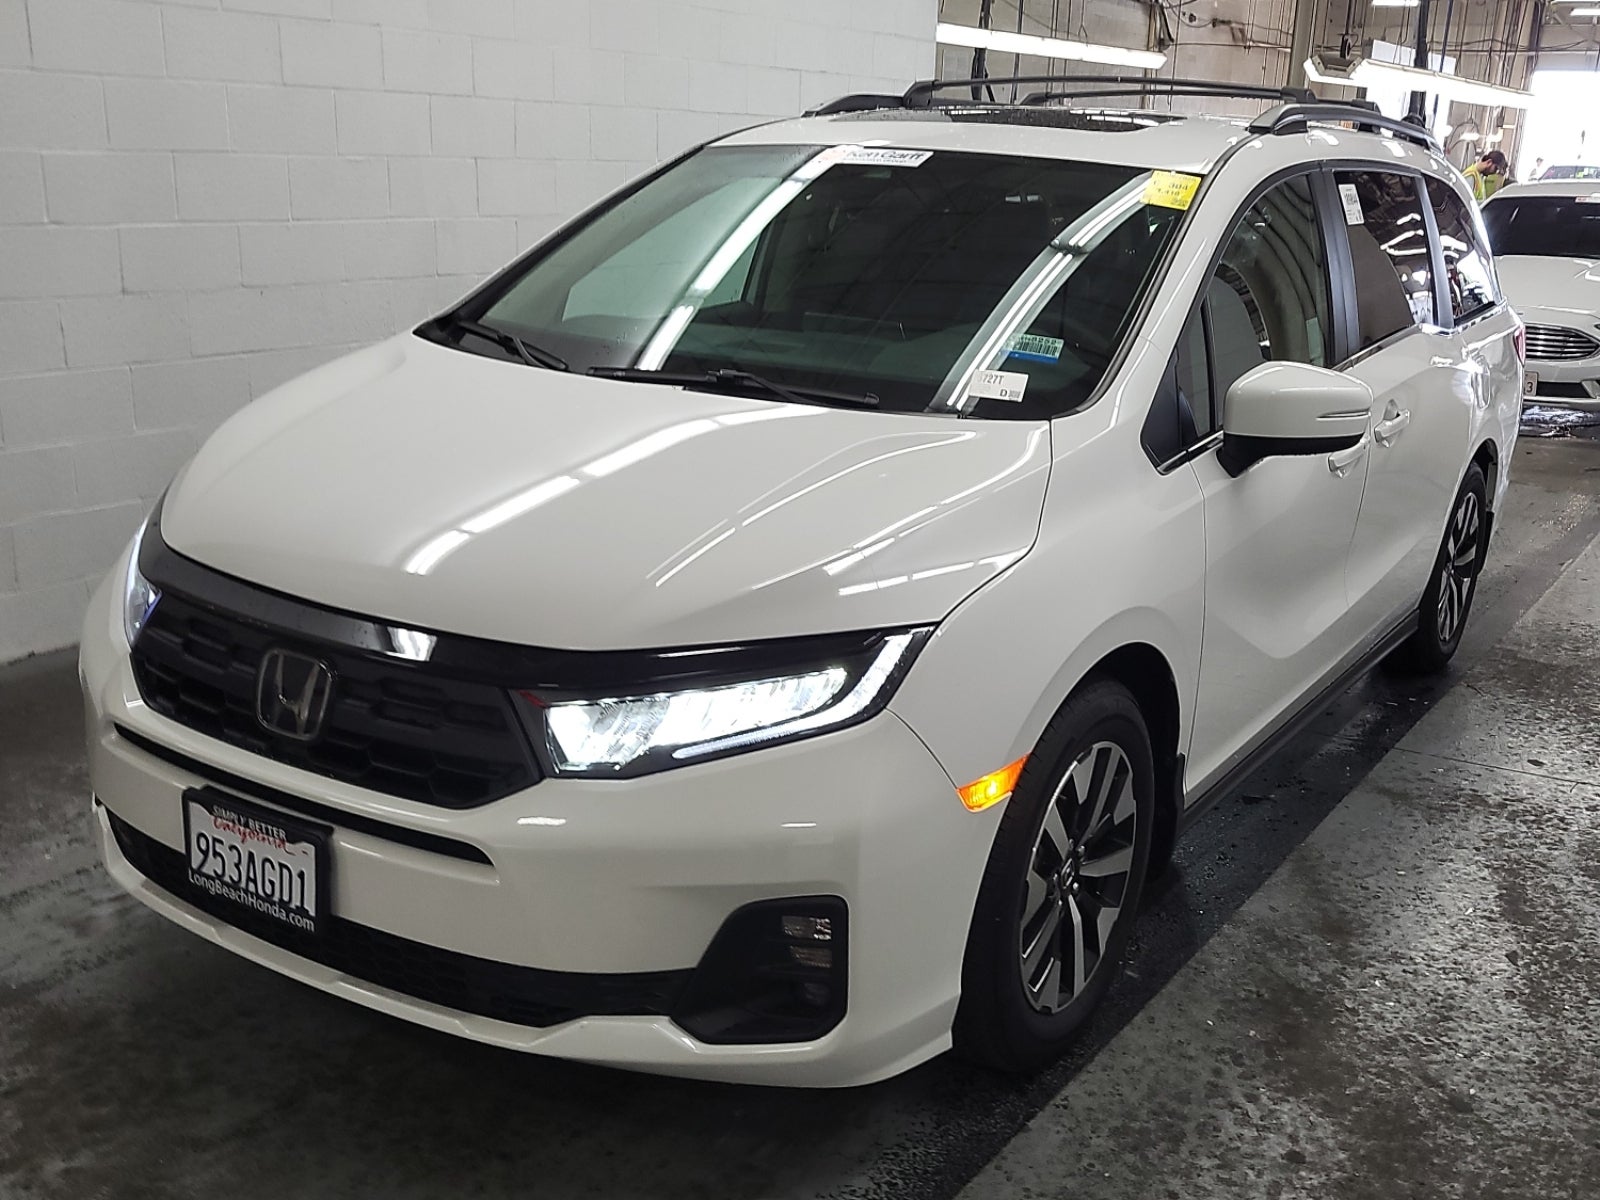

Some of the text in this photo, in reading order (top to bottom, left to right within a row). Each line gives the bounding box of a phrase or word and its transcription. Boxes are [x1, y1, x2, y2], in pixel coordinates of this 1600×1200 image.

[999, 388, 1008, 397] D
[249, 821, 287, 841] BETTER
[195, 831, 306, 909] 953AGD1
[188, 868, 315, 932] LongBeachHonda.com
